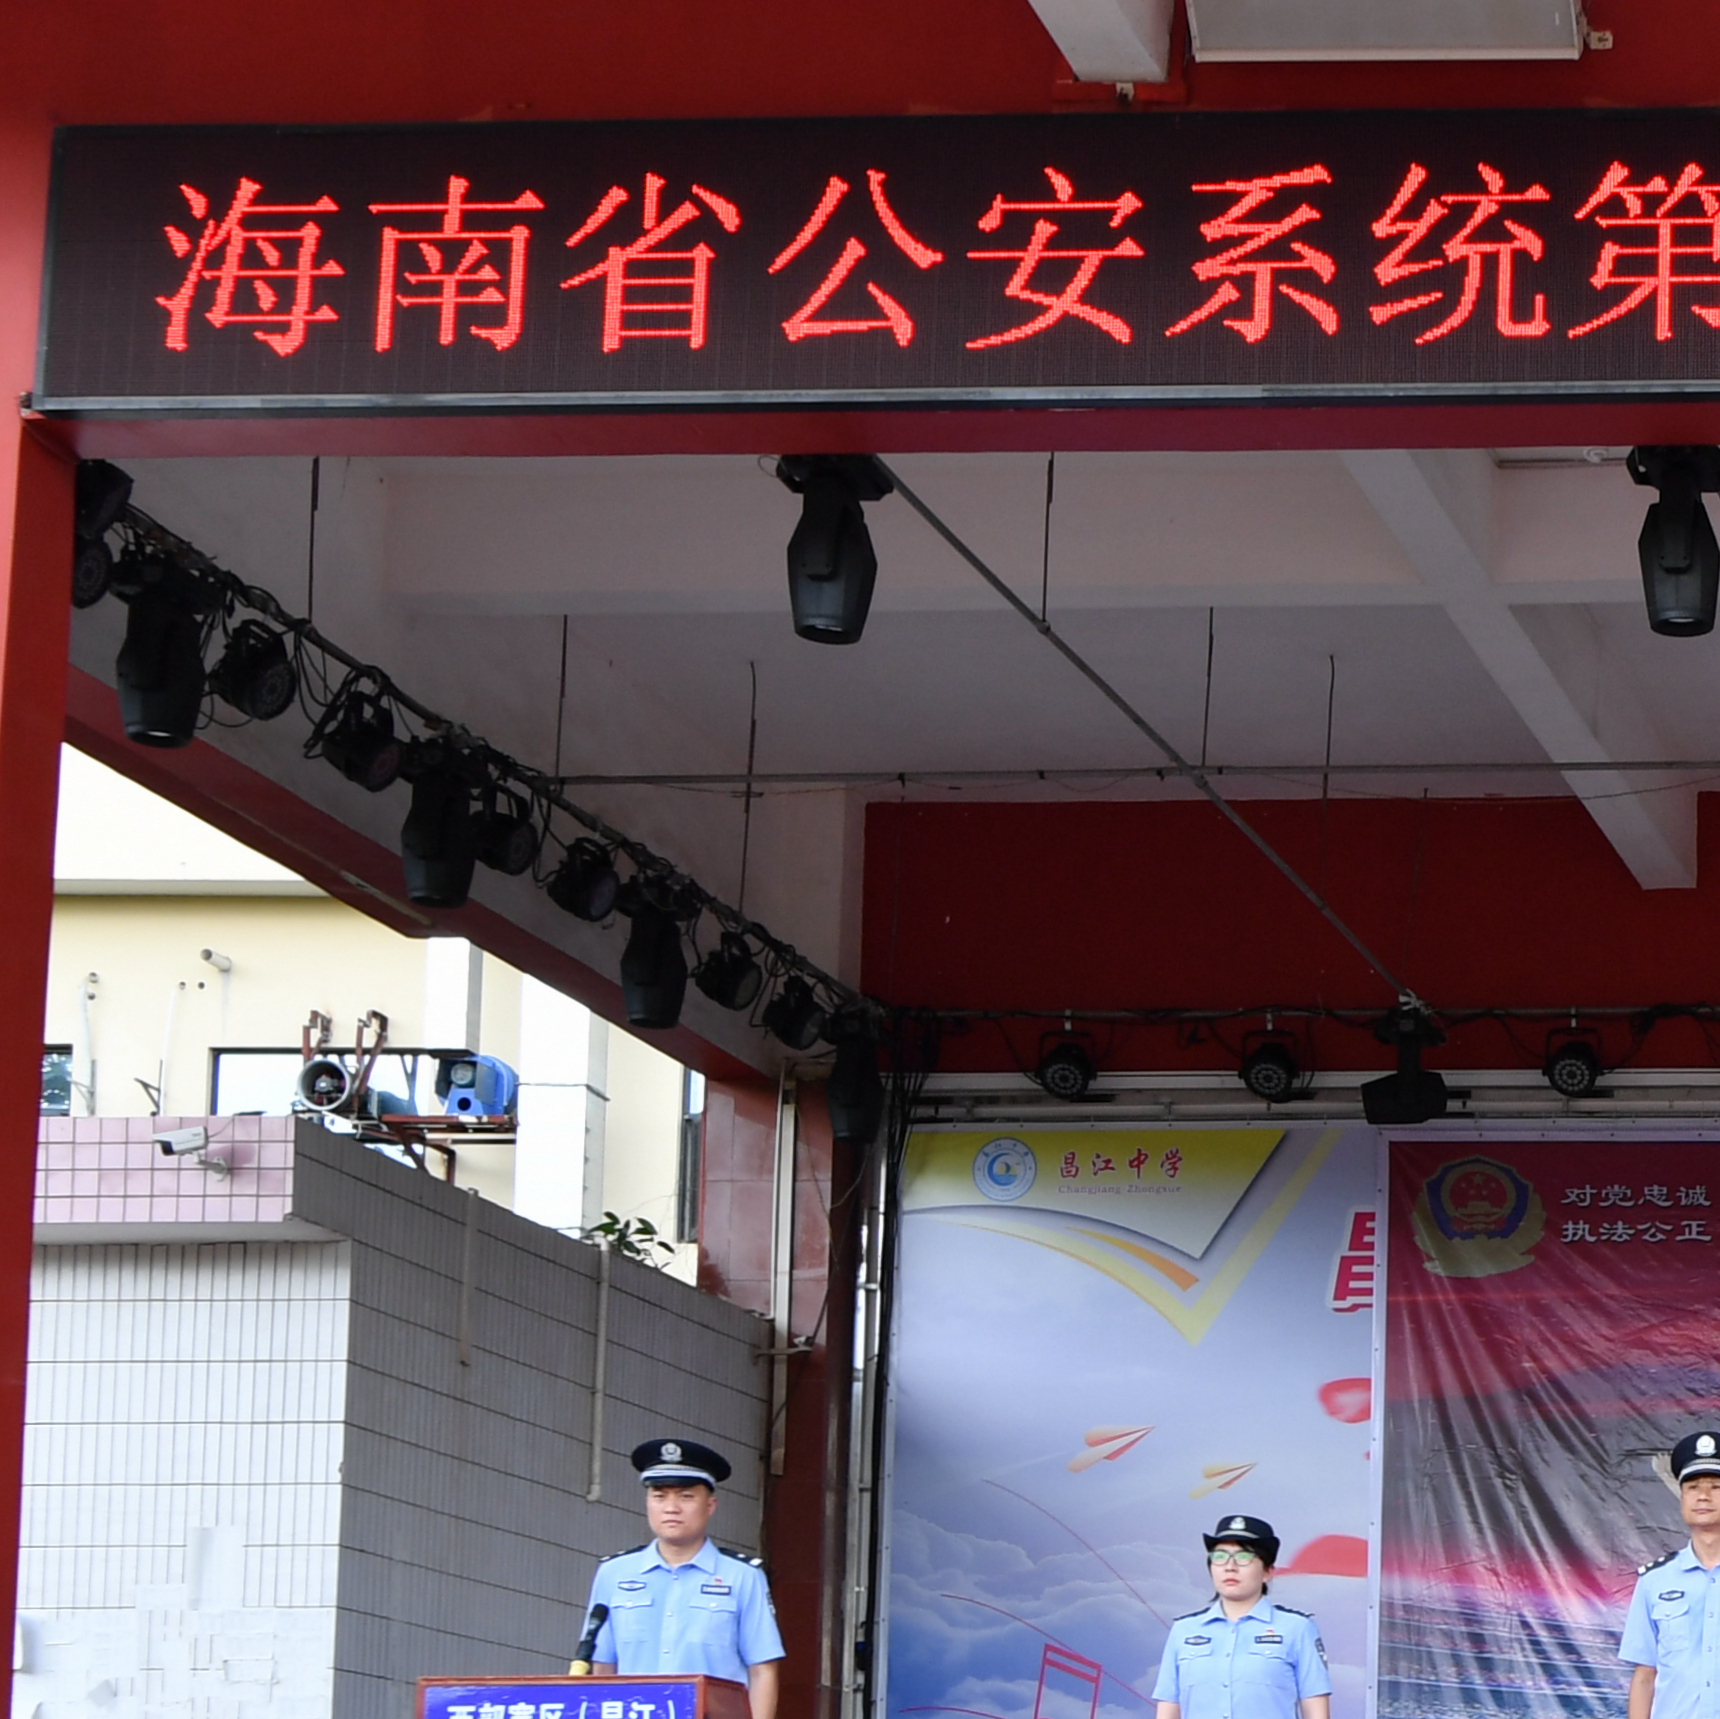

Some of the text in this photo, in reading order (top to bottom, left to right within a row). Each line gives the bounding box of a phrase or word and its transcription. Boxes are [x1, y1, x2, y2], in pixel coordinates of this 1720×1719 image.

[1060, 1147, 1183, 1179] 昌江中学
[1059, 1184, 1182, 1195] Changjiang Zhongxue
[1561, 1185, 1712, 1207] 对党忠诚
[1561, 1221, 1712, 1243] 执法公正
